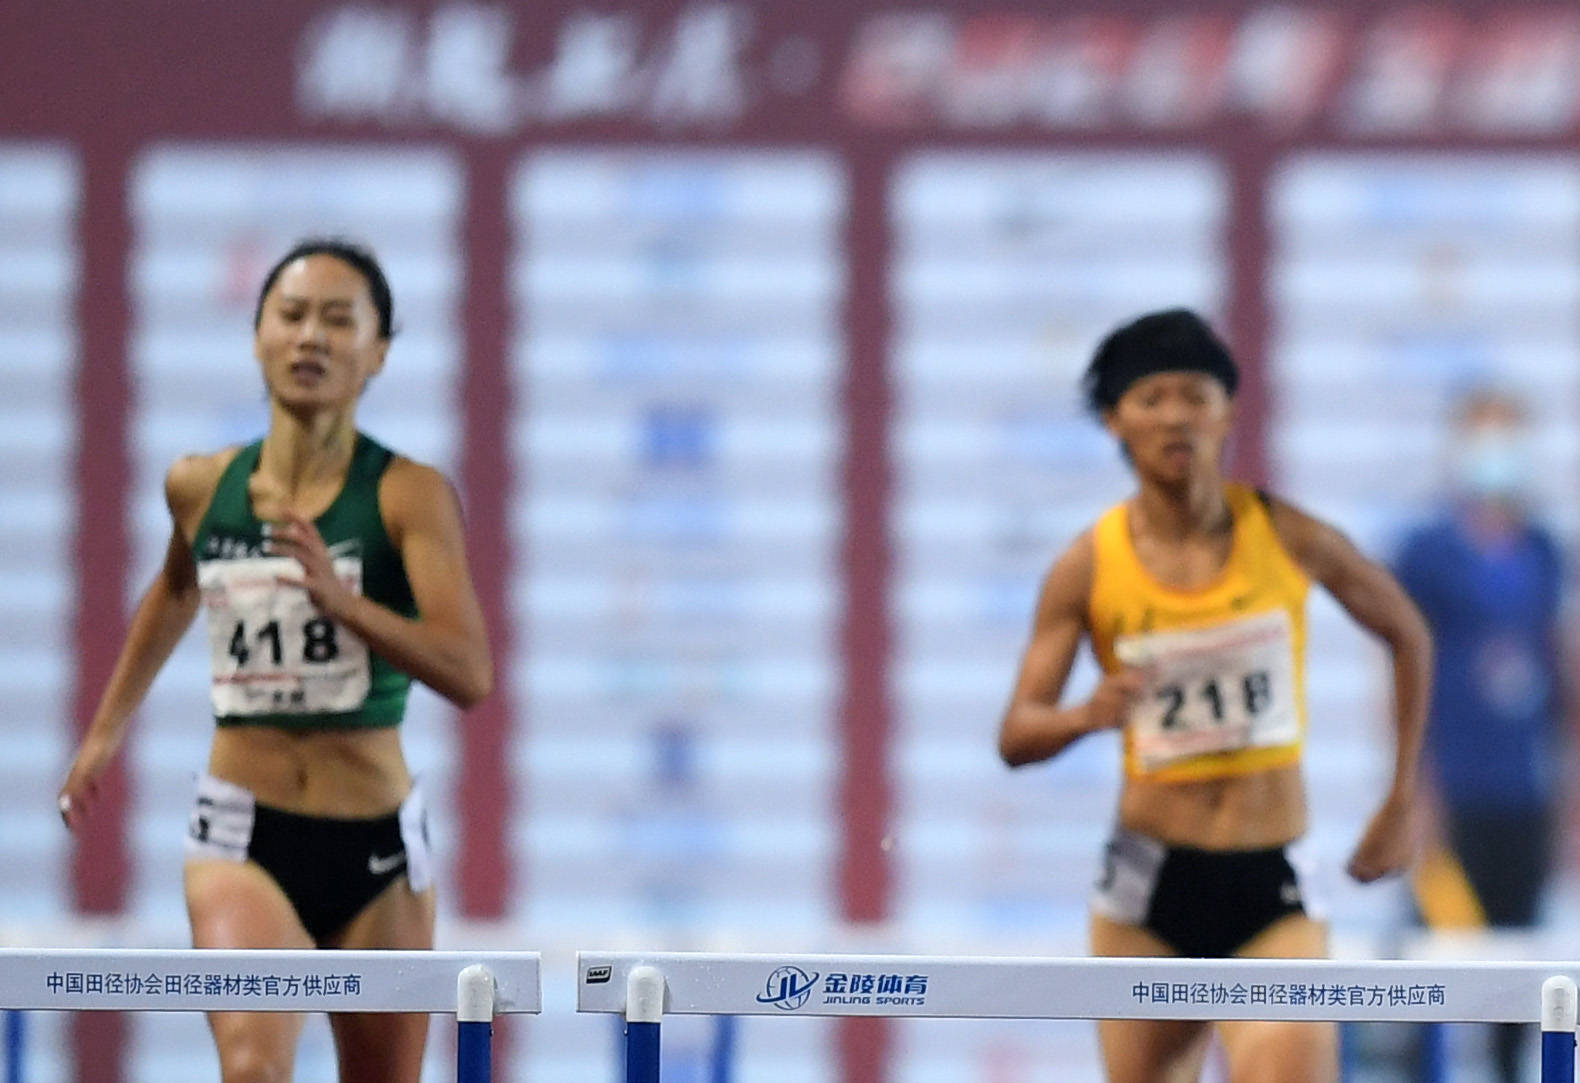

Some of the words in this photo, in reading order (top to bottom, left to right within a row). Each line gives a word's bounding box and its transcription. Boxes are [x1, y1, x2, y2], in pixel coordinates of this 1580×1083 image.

[229, 620, 339, 666] 418
[1156, 670, 1273, 730] 218
[46, 971, 362, 997] 中国田径协会田径器材类官方供应商
[822, 973, 929, 995] 金陵体育
[1132, 981, 1446, 1007] 中国田径协会田径器材类官方供应商
[823, 996, 871, 1005] JINLING
[875, 997, 926, 1006] SPORTS
